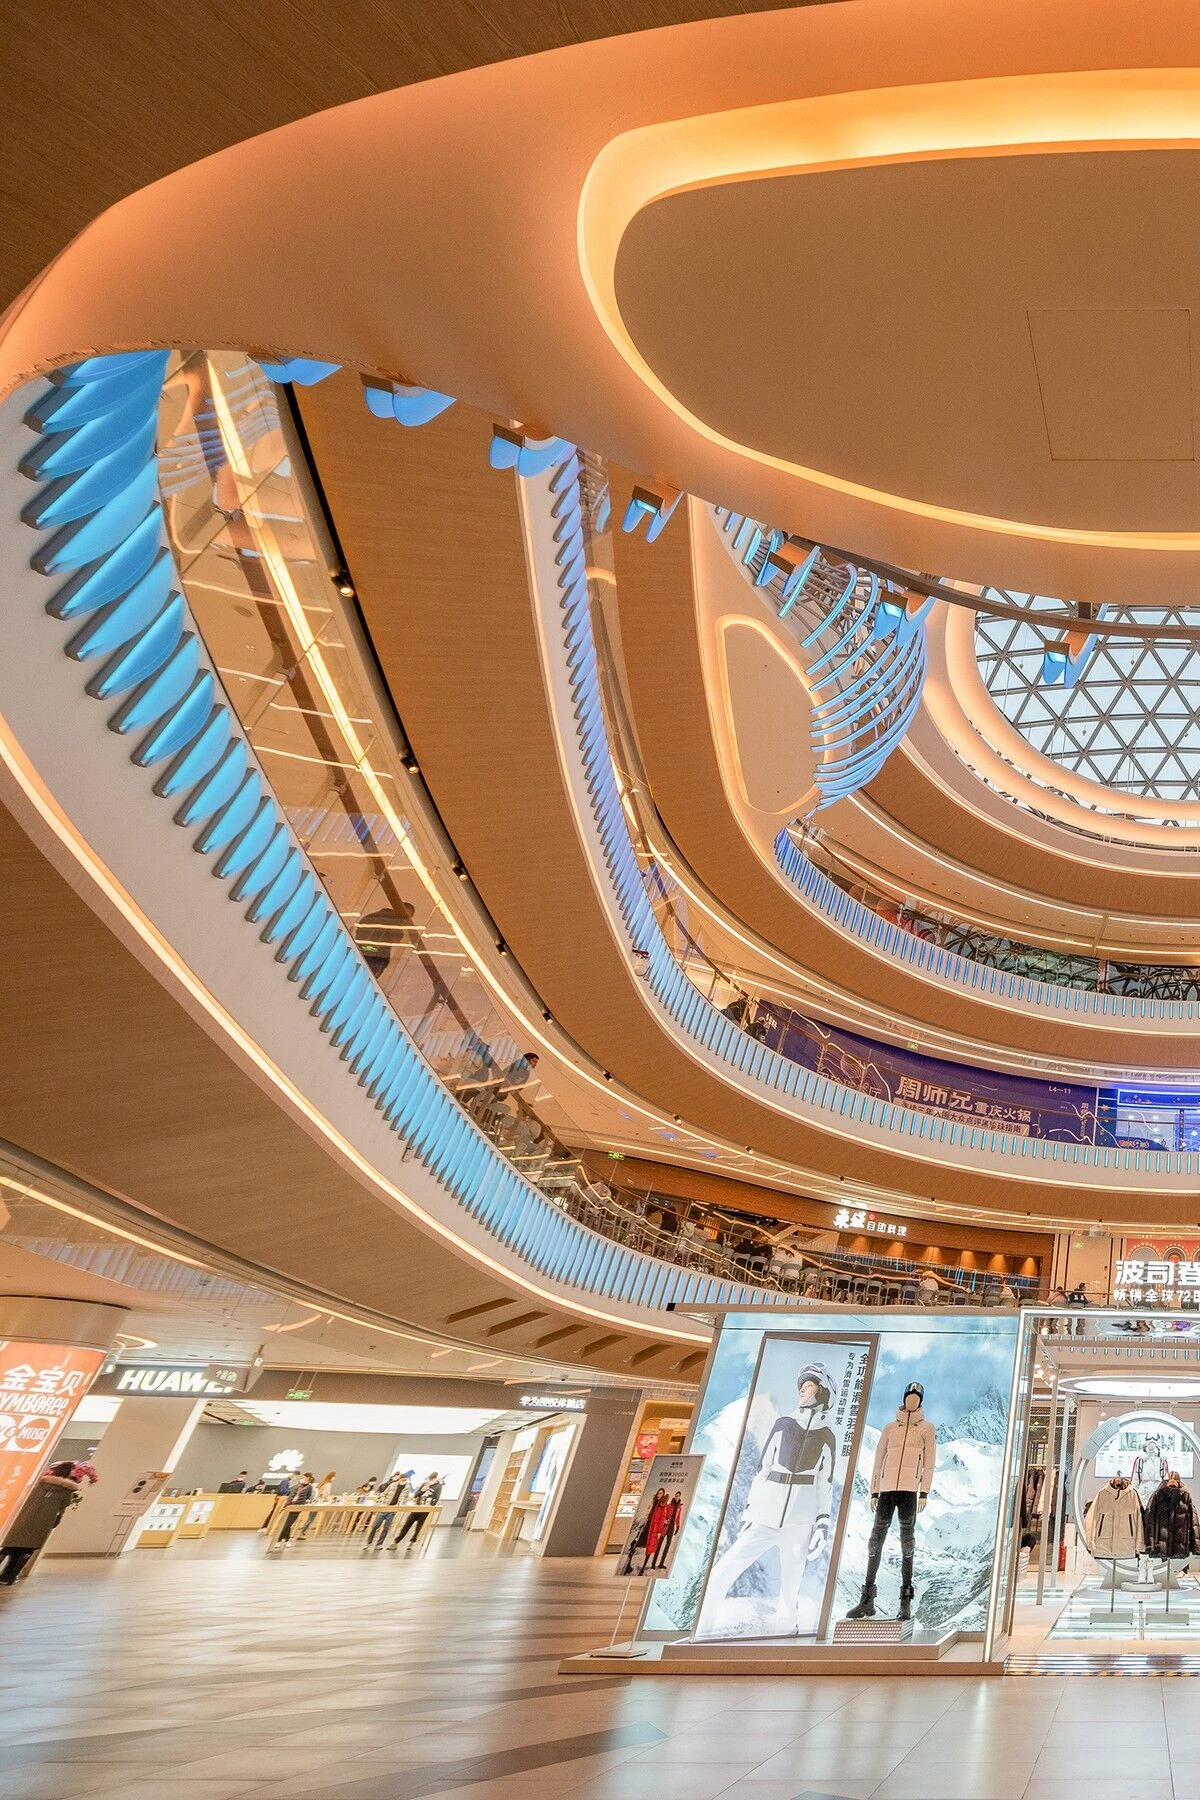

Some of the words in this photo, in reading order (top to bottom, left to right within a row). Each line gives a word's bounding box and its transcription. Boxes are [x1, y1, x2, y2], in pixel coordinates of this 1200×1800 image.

[895, 1075, 973, 1111] 周师兄
[974, 1101, 1032, 1123] 重庆火锅
[835, 1352, 856, 1426] 专为滑雪运动研发
